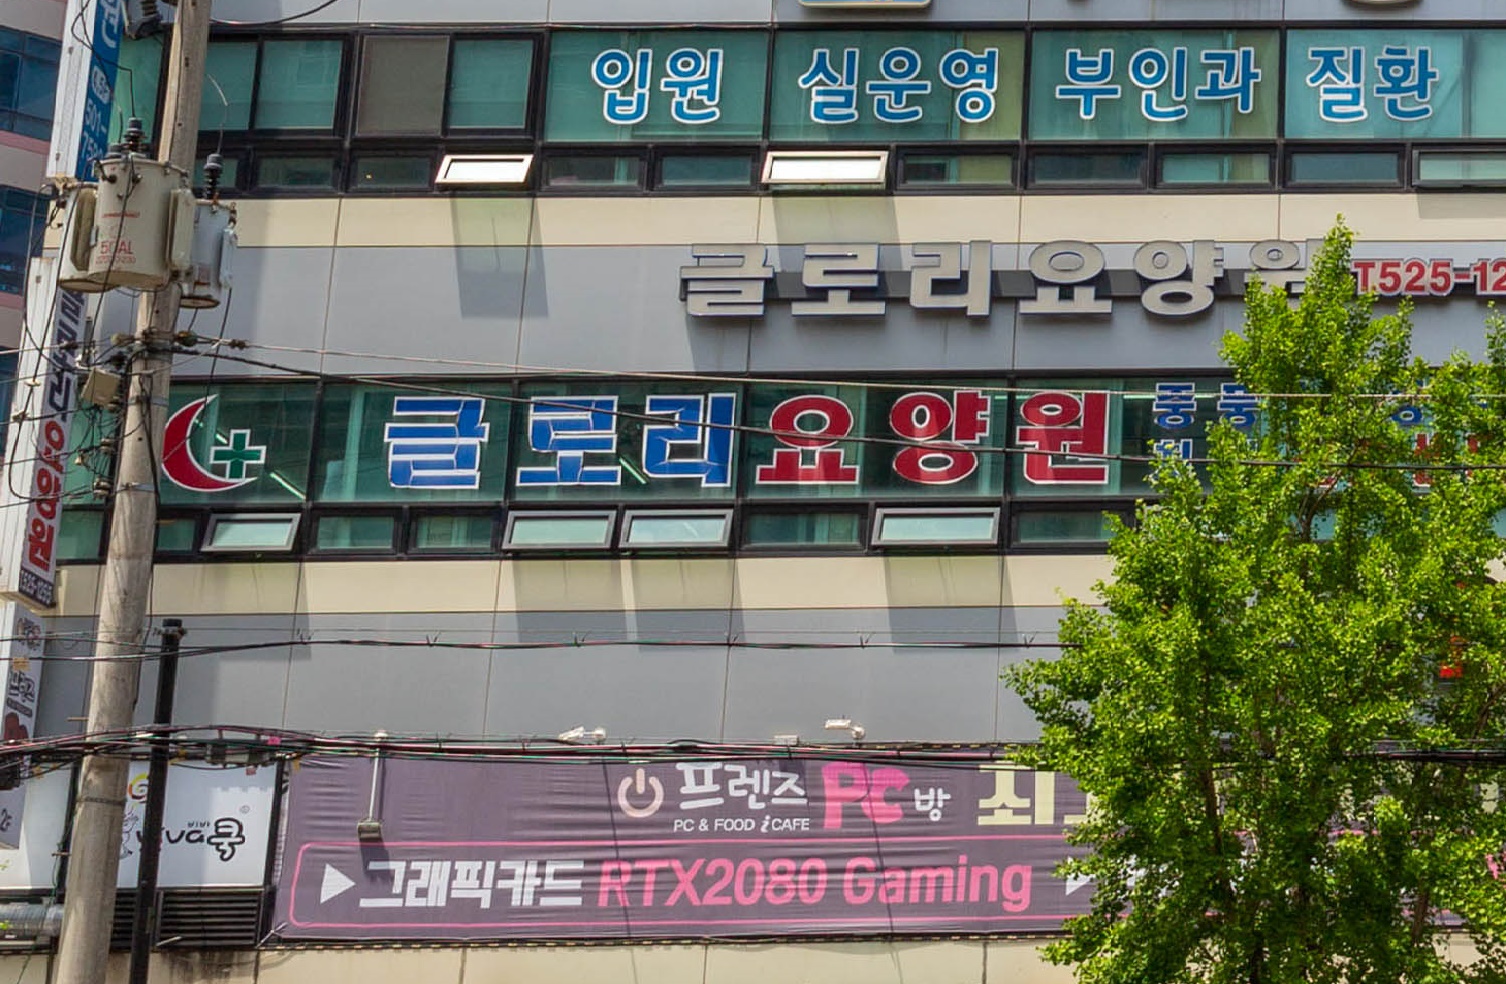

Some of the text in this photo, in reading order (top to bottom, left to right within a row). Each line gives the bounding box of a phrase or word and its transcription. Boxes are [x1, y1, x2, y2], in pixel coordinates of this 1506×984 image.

[1055, 46, 1261, 121] 부인과
[1306, 46, 1438, 123] 질환
[675, 761, 808, 810] 프렌즈
[673, 818, 696, 833] PC
[698, 818, 710, 832] &
[714, 817, 756, 832] FOOD
[358, 859, 584, 909] 그래픽카드
[597, 857, 827, 907] RTX2080
[842, 853, 1033, 913] Gaming
